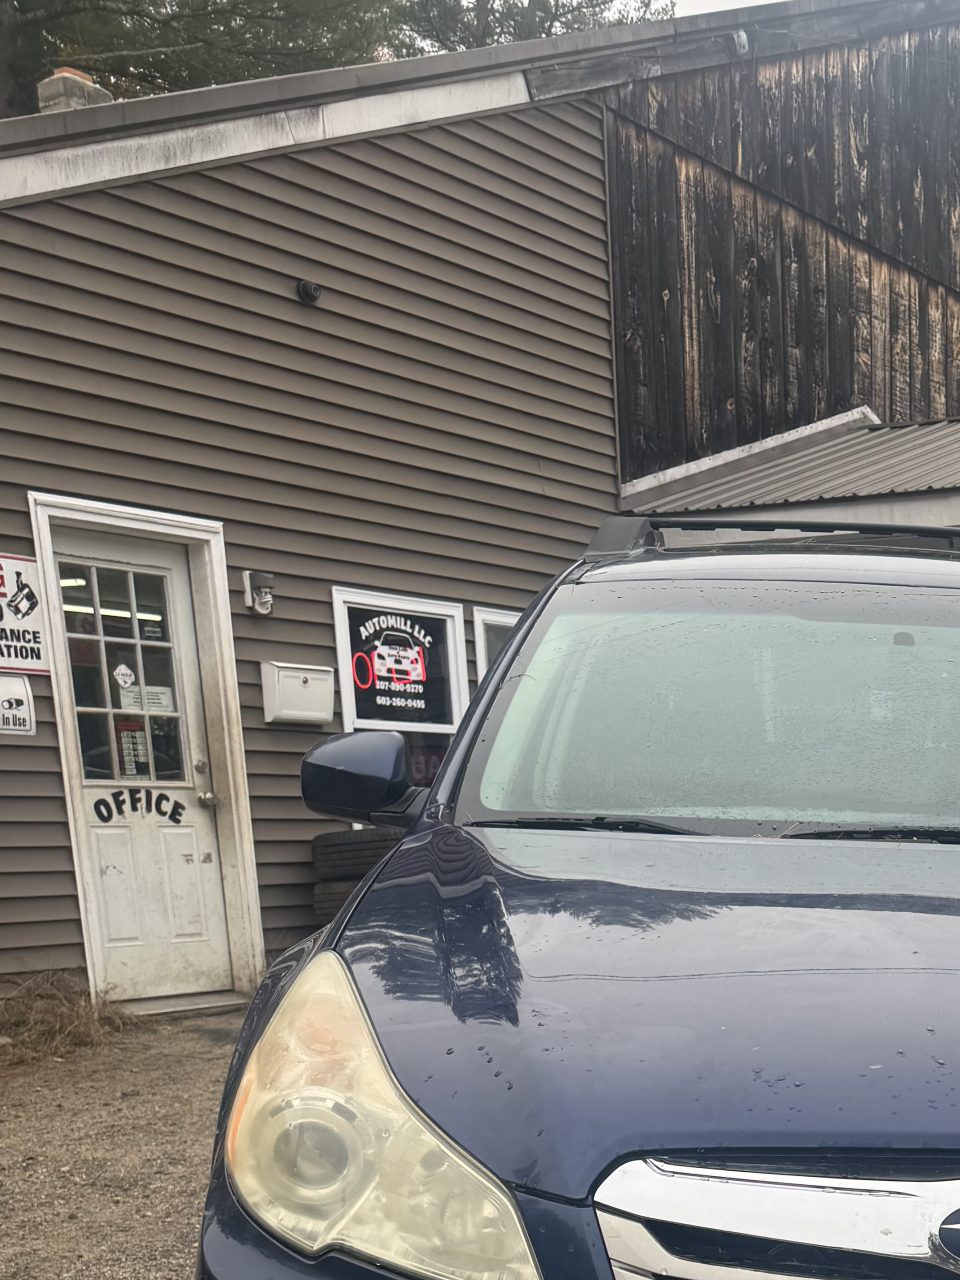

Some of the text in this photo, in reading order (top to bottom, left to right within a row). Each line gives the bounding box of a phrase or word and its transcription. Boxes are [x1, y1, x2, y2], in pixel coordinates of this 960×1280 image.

[359, 614, 433, 648] AUTOMILL LLC
[2, 713, 27, 728] In Use
[93, 788, 187, 825] OFFICE
